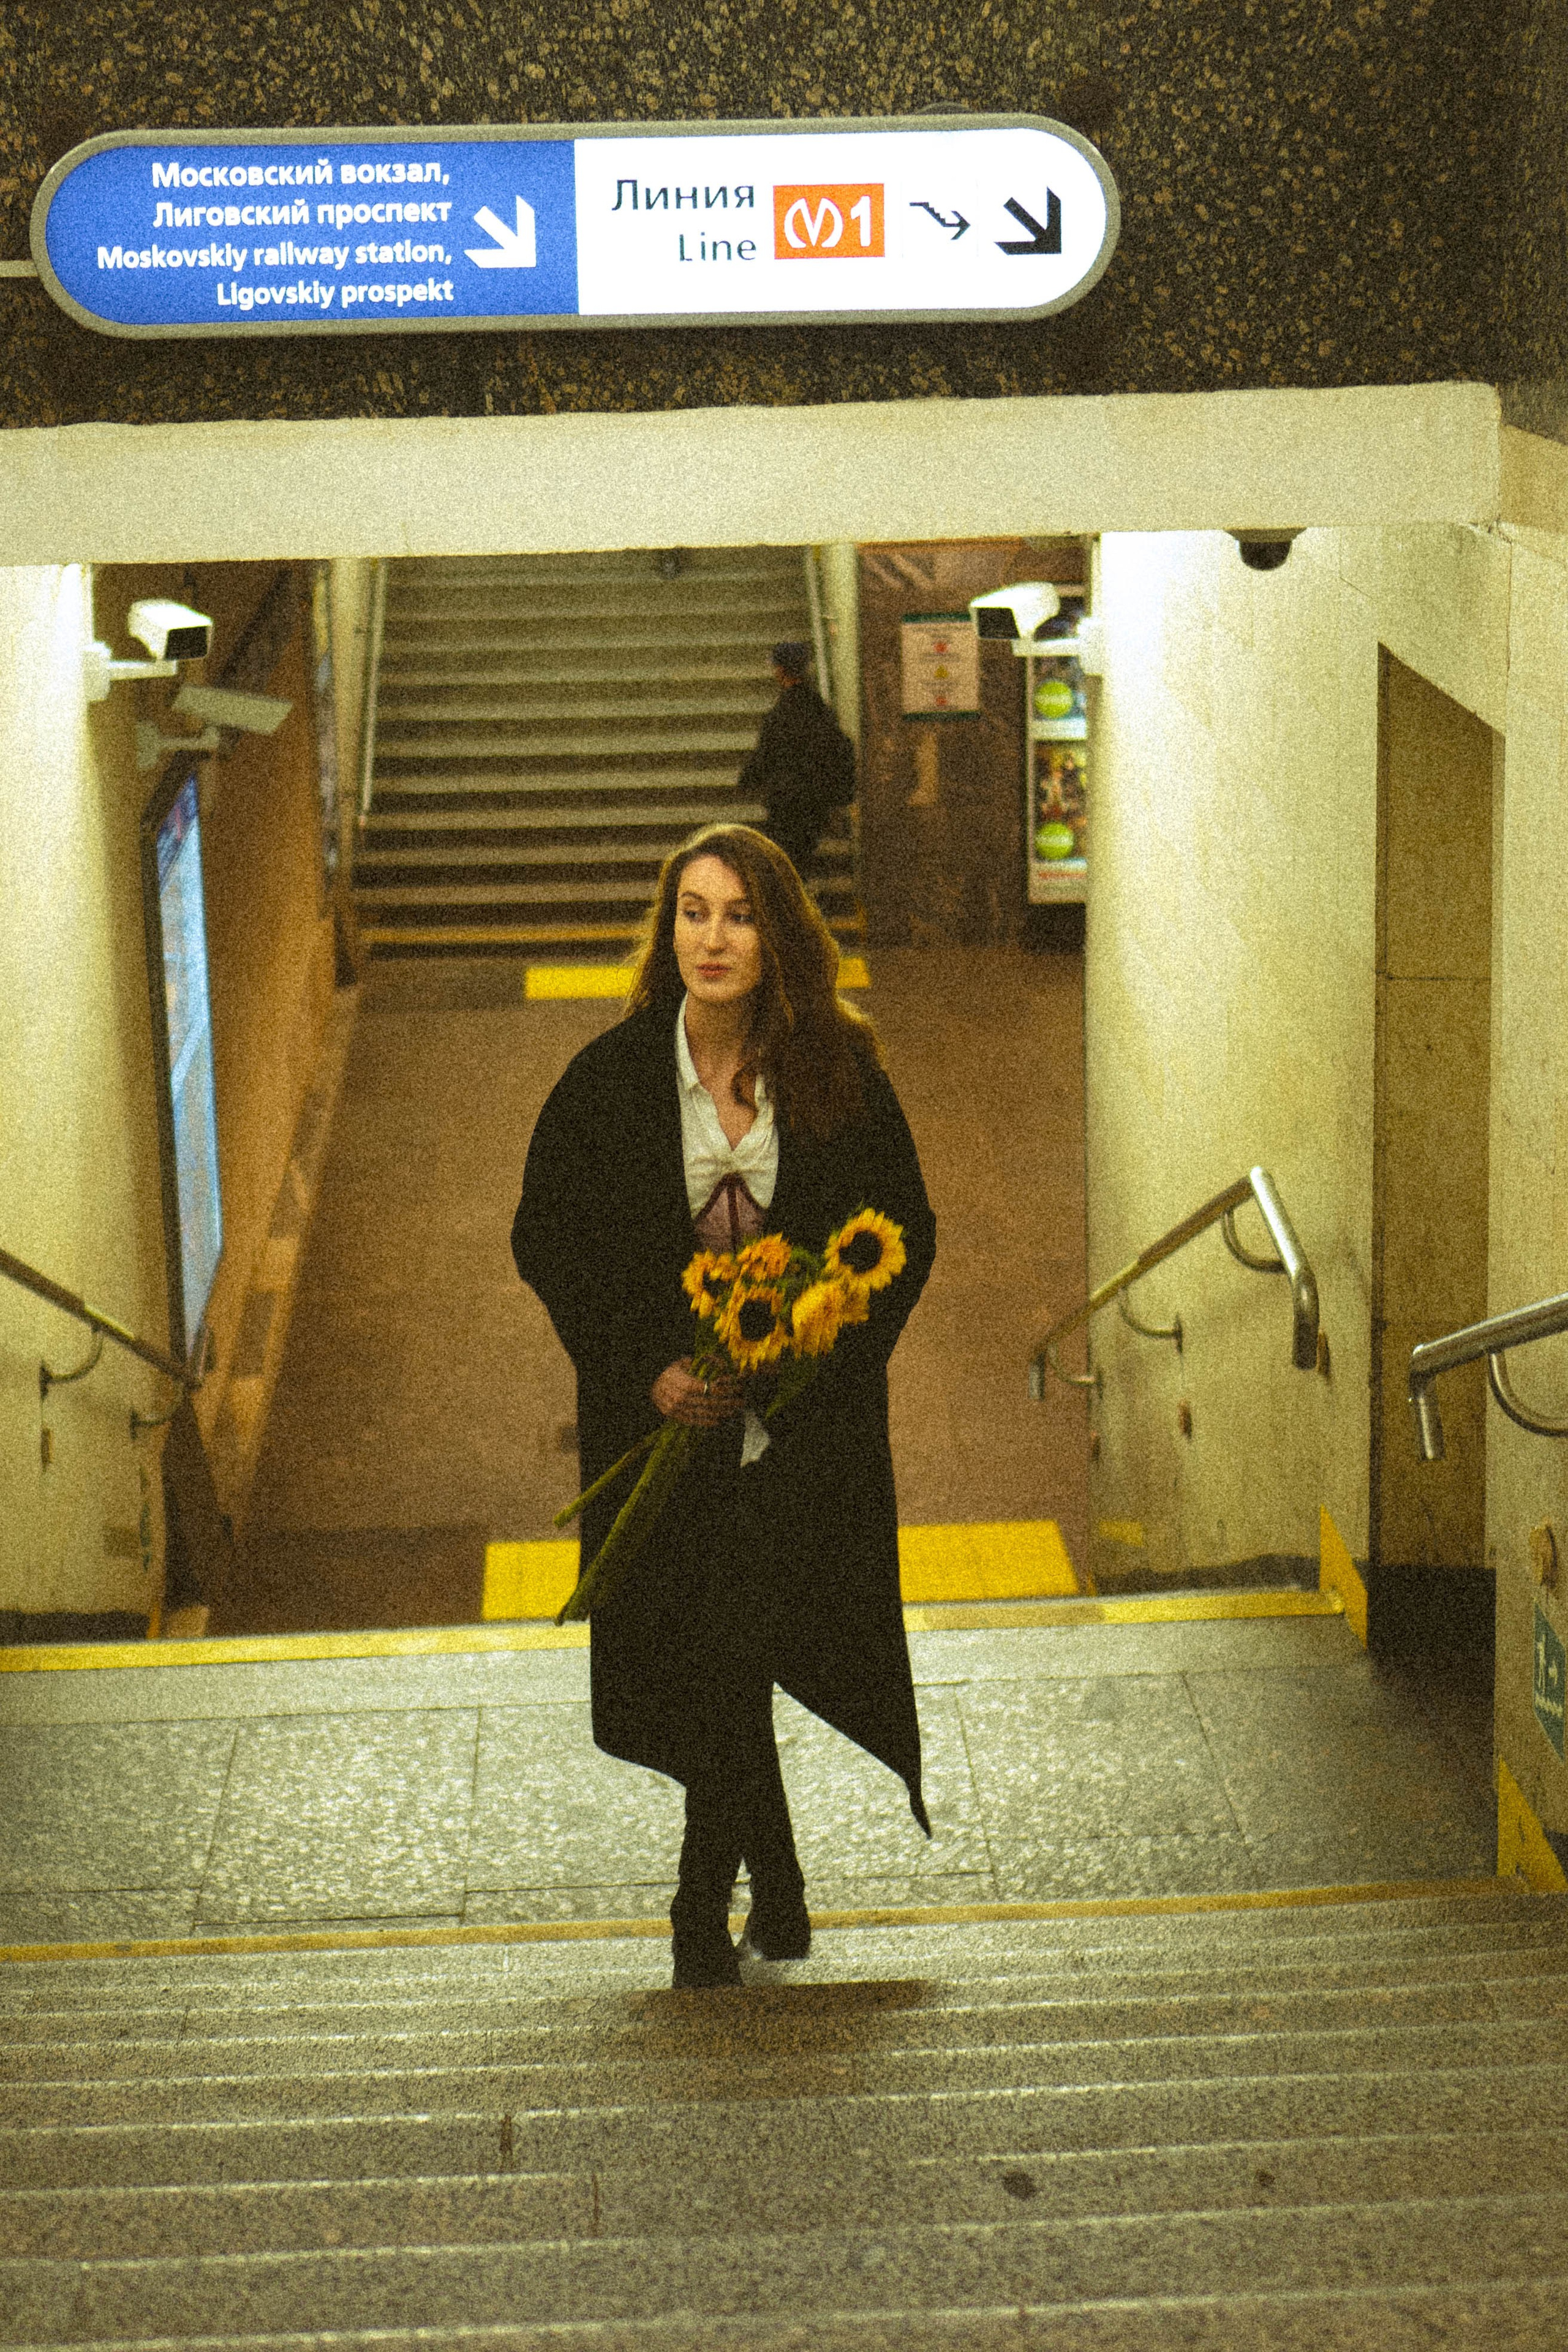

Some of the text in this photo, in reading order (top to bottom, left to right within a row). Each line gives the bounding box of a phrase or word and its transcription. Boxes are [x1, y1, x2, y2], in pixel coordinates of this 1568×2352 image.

[153, 159, 450, 187] Московский вокзал,
[612, 179, 755, 210] Линия
[153, 198, 452, 230] Лиговский проспект
[98, 239, 452, 271] Moskovskiy railway station,
[679, 232, 757, 262] Line
[217, 278, 453, 309] Ligovskiy prospekt
